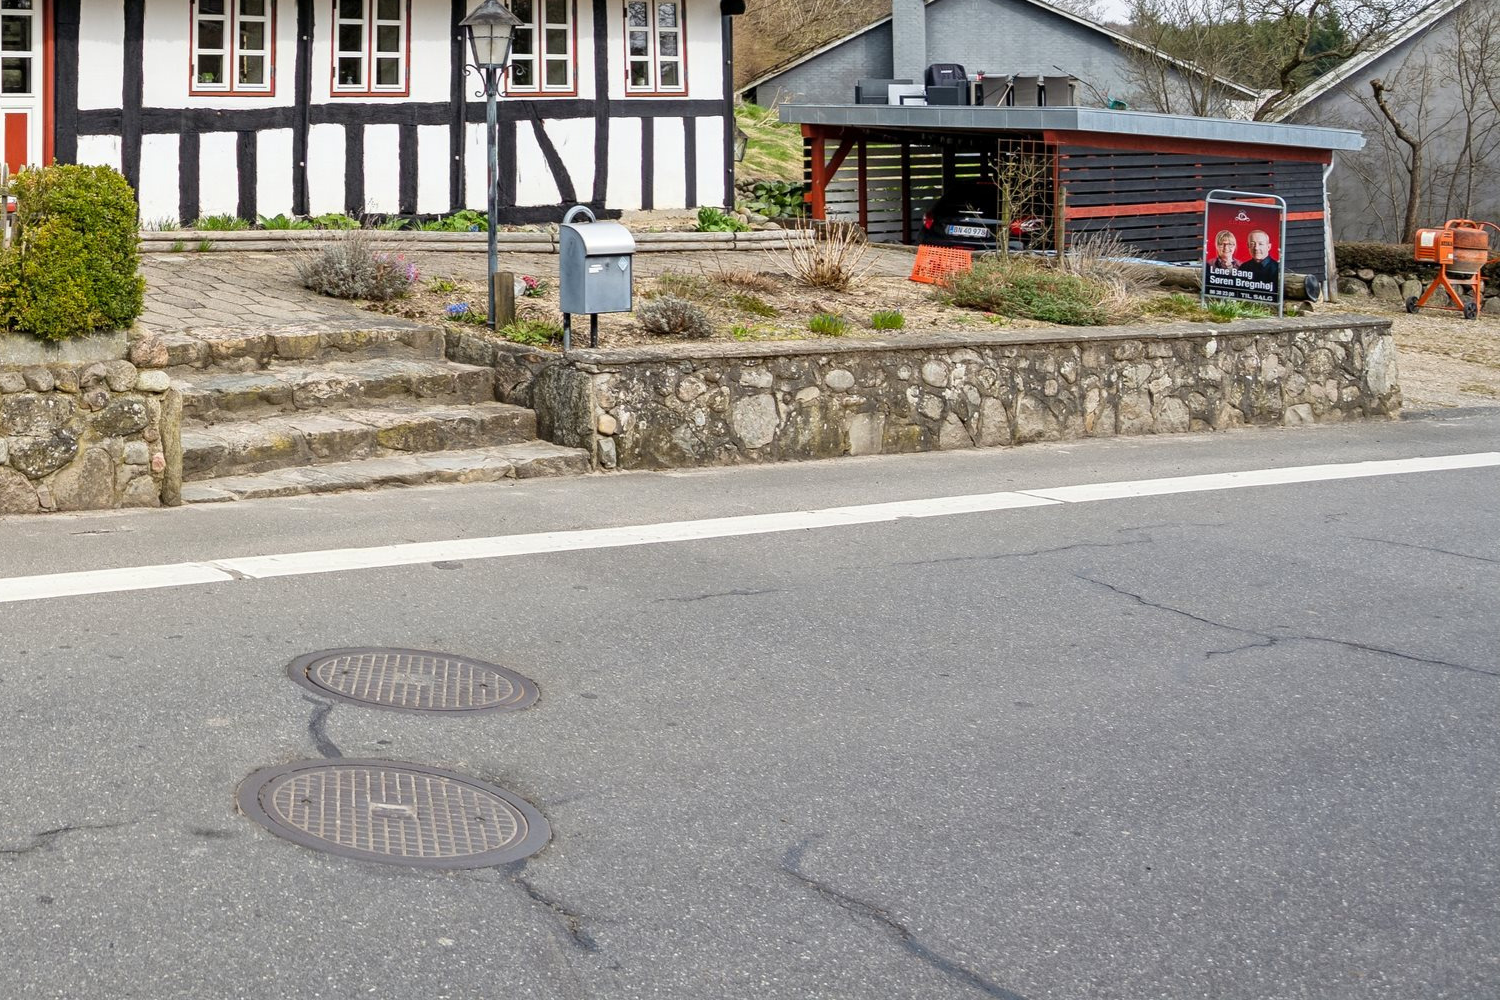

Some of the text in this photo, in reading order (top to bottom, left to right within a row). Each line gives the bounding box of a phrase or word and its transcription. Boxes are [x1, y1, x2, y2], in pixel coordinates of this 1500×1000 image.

[1210, 266, 1253, 279] Lene Bang
[1210, 275, 1273, 291] Søren Bregnhøj
